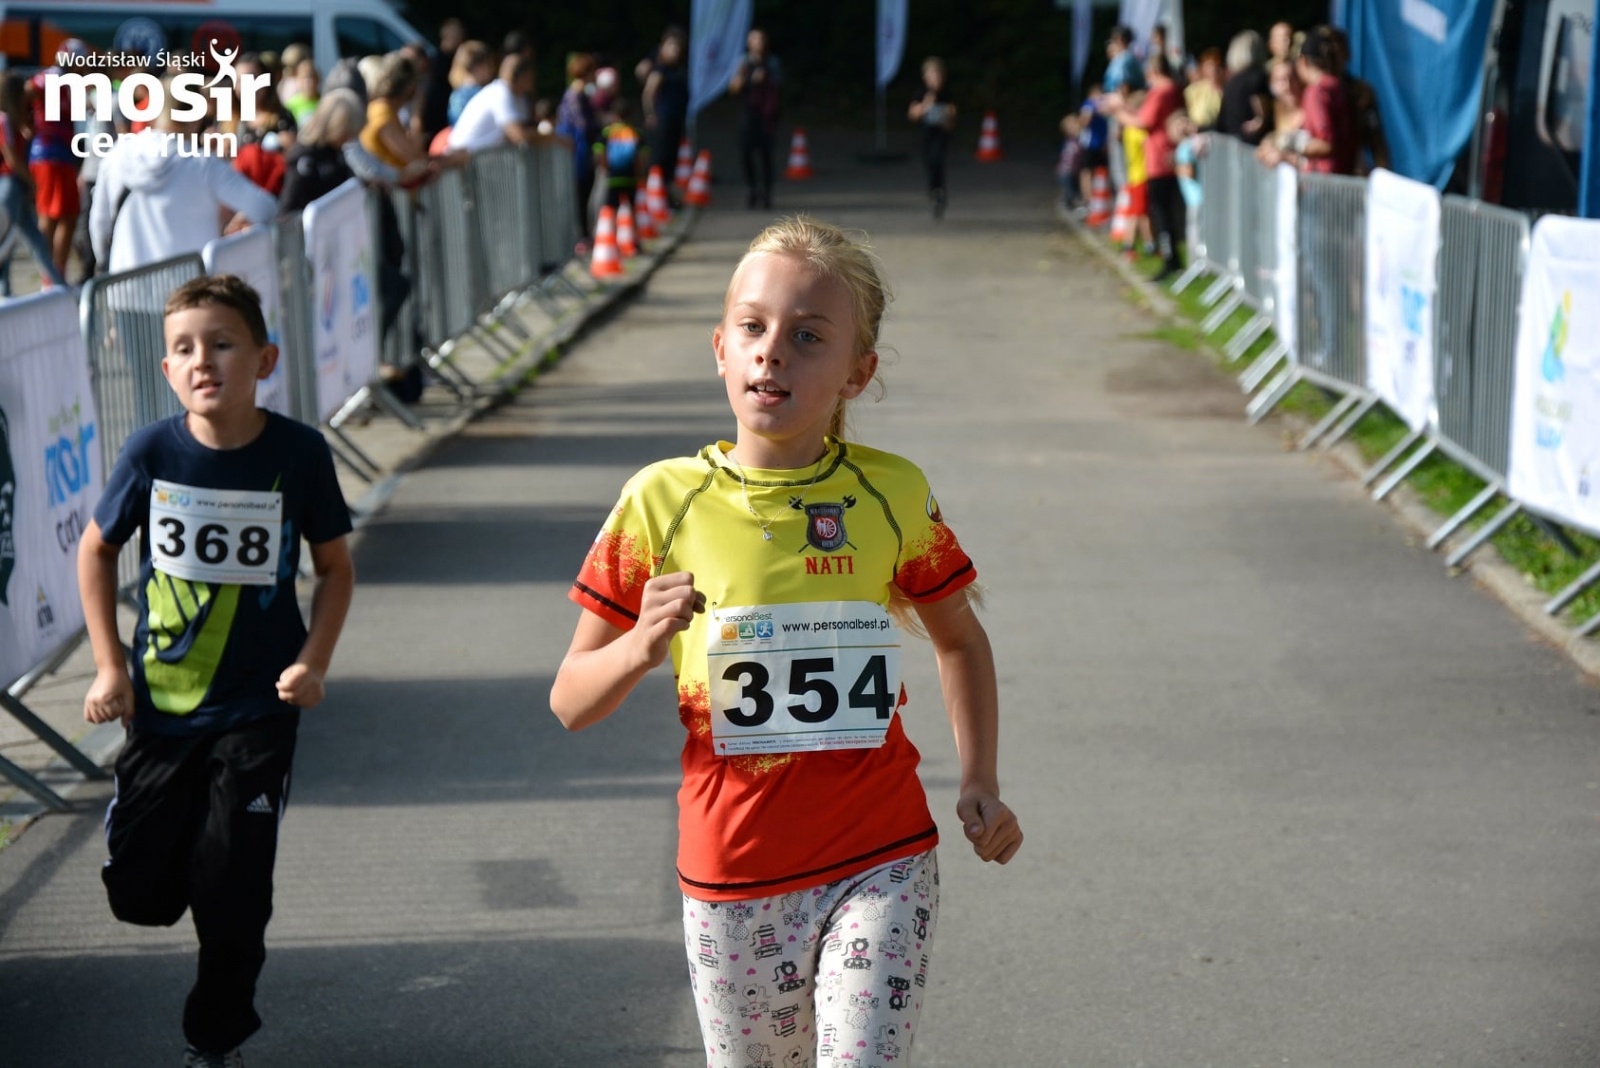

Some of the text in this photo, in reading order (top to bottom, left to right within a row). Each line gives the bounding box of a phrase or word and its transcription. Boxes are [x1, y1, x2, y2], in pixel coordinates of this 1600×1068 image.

[157, 517, 270, 567] 368
[805, 555, 855, 575] NATI
[722, 612, 773, 623] ersonalBest
[782, 618, 890, 633] www.personalbest.pl
[721, 655, 896, 727] 354
